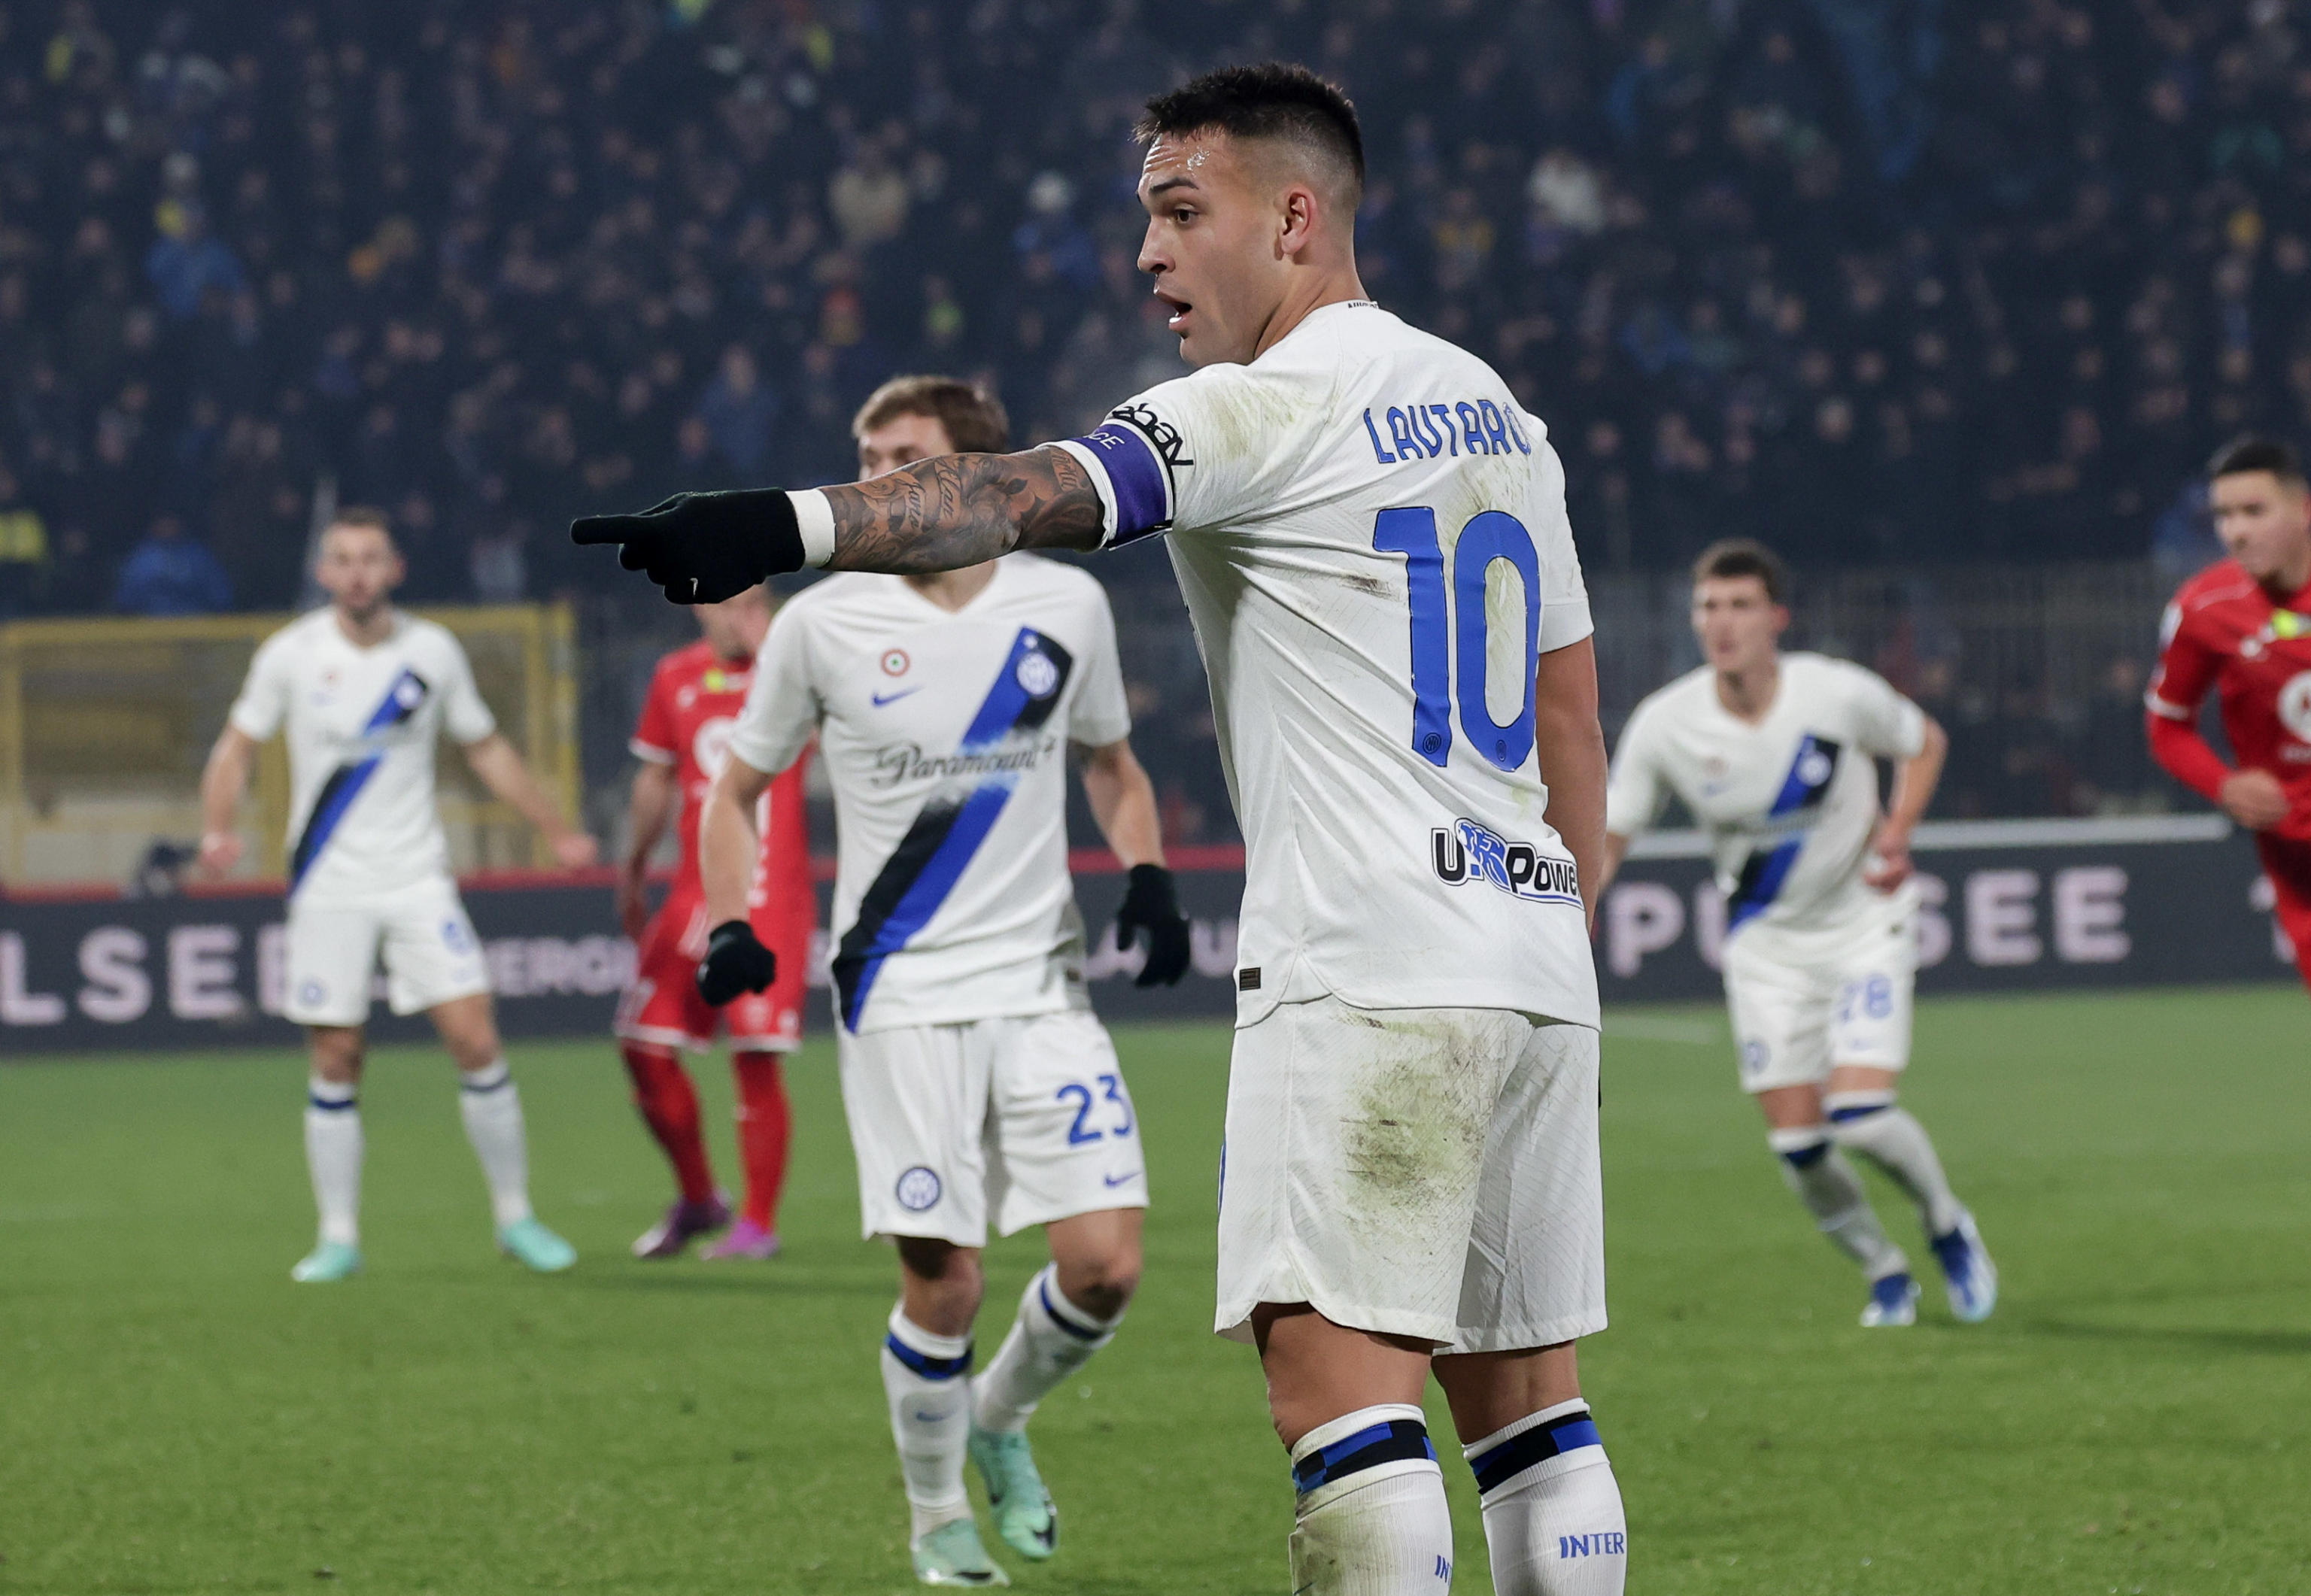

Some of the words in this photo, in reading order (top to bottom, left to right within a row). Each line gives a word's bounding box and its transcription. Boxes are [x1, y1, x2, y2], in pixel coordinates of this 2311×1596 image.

[1364, 399, 1532, 463] LAUTARO
[1373, 506, 1540, 772] 10
[1056, 1074, 1133, 1145] 23
[1559, 1532, 1624, 1559] INTER
